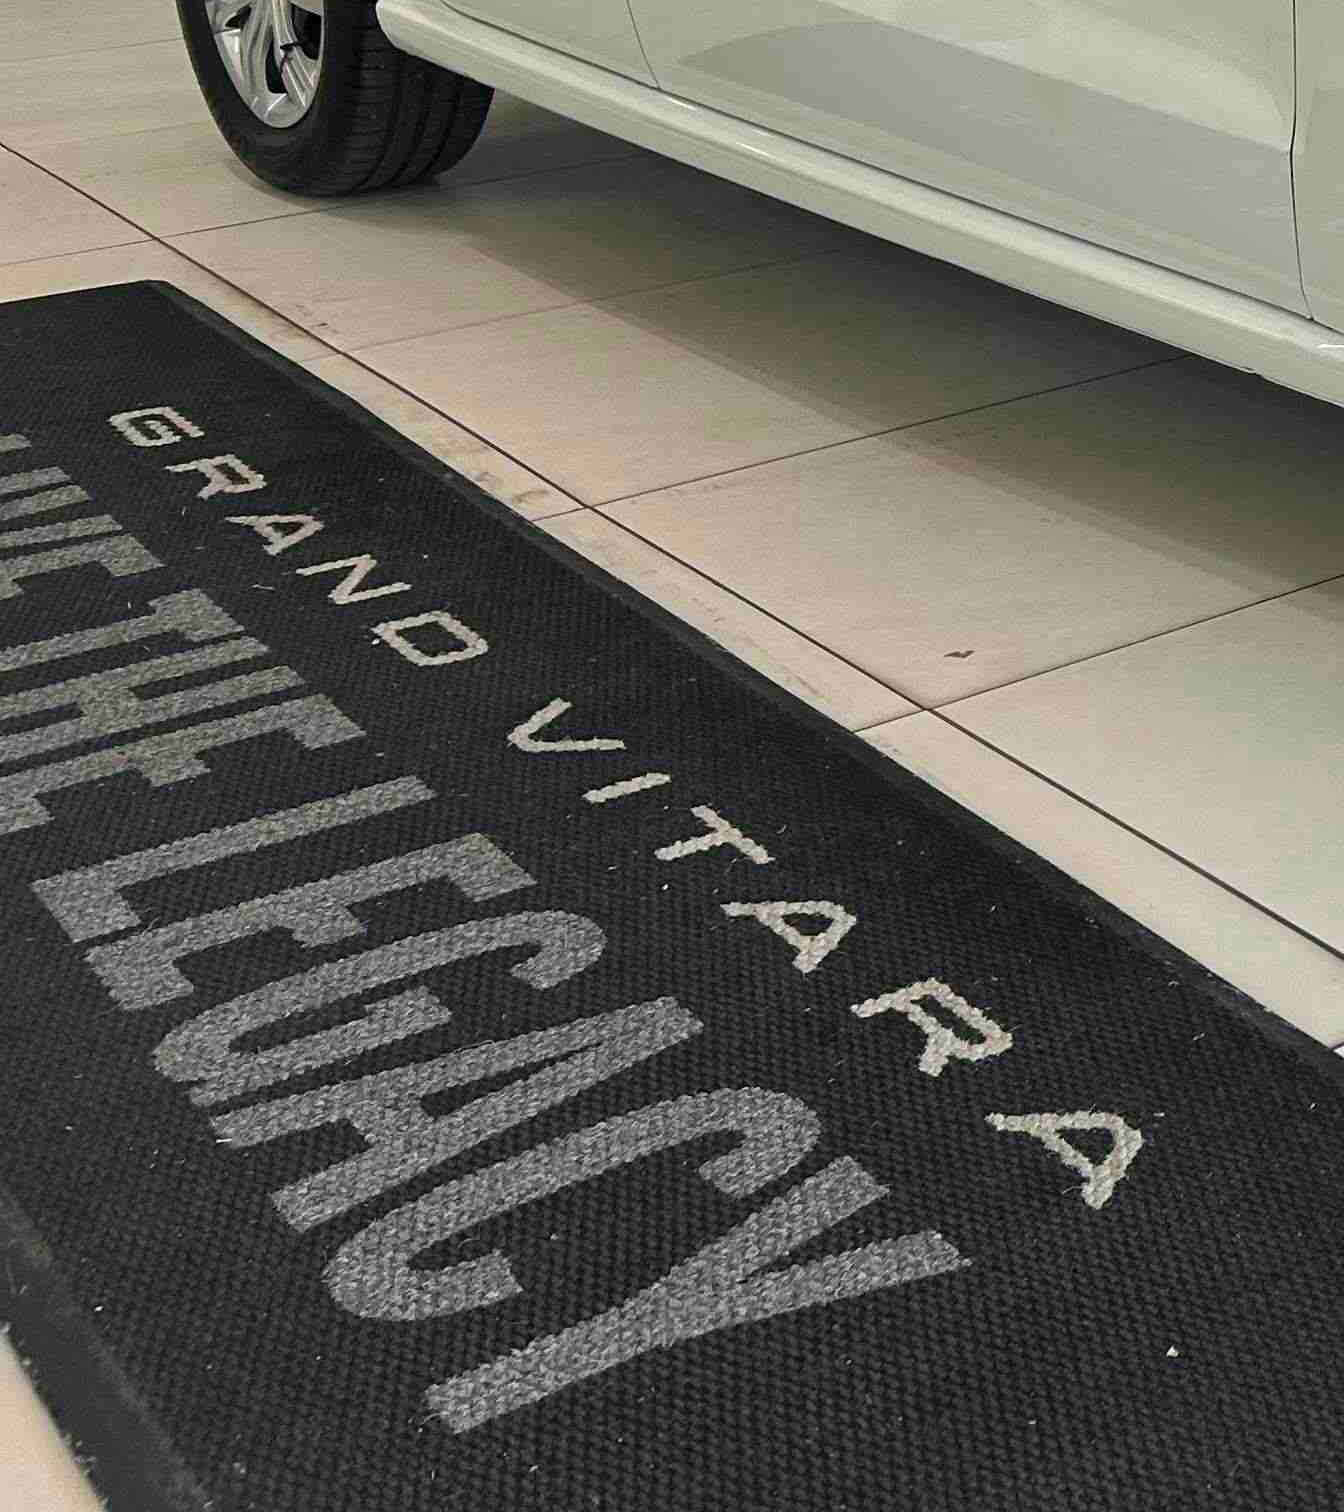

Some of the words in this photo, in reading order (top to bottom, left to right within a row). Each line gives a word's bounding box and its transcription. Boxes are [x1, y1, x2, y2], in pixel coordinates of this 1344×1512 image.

[0, 589, 366, 836] THE
[108, 405, 489, 667] GRAND
[507, 697, 1144, 1210] VITARA
[33, 774, 973, 1434] LEGACY
